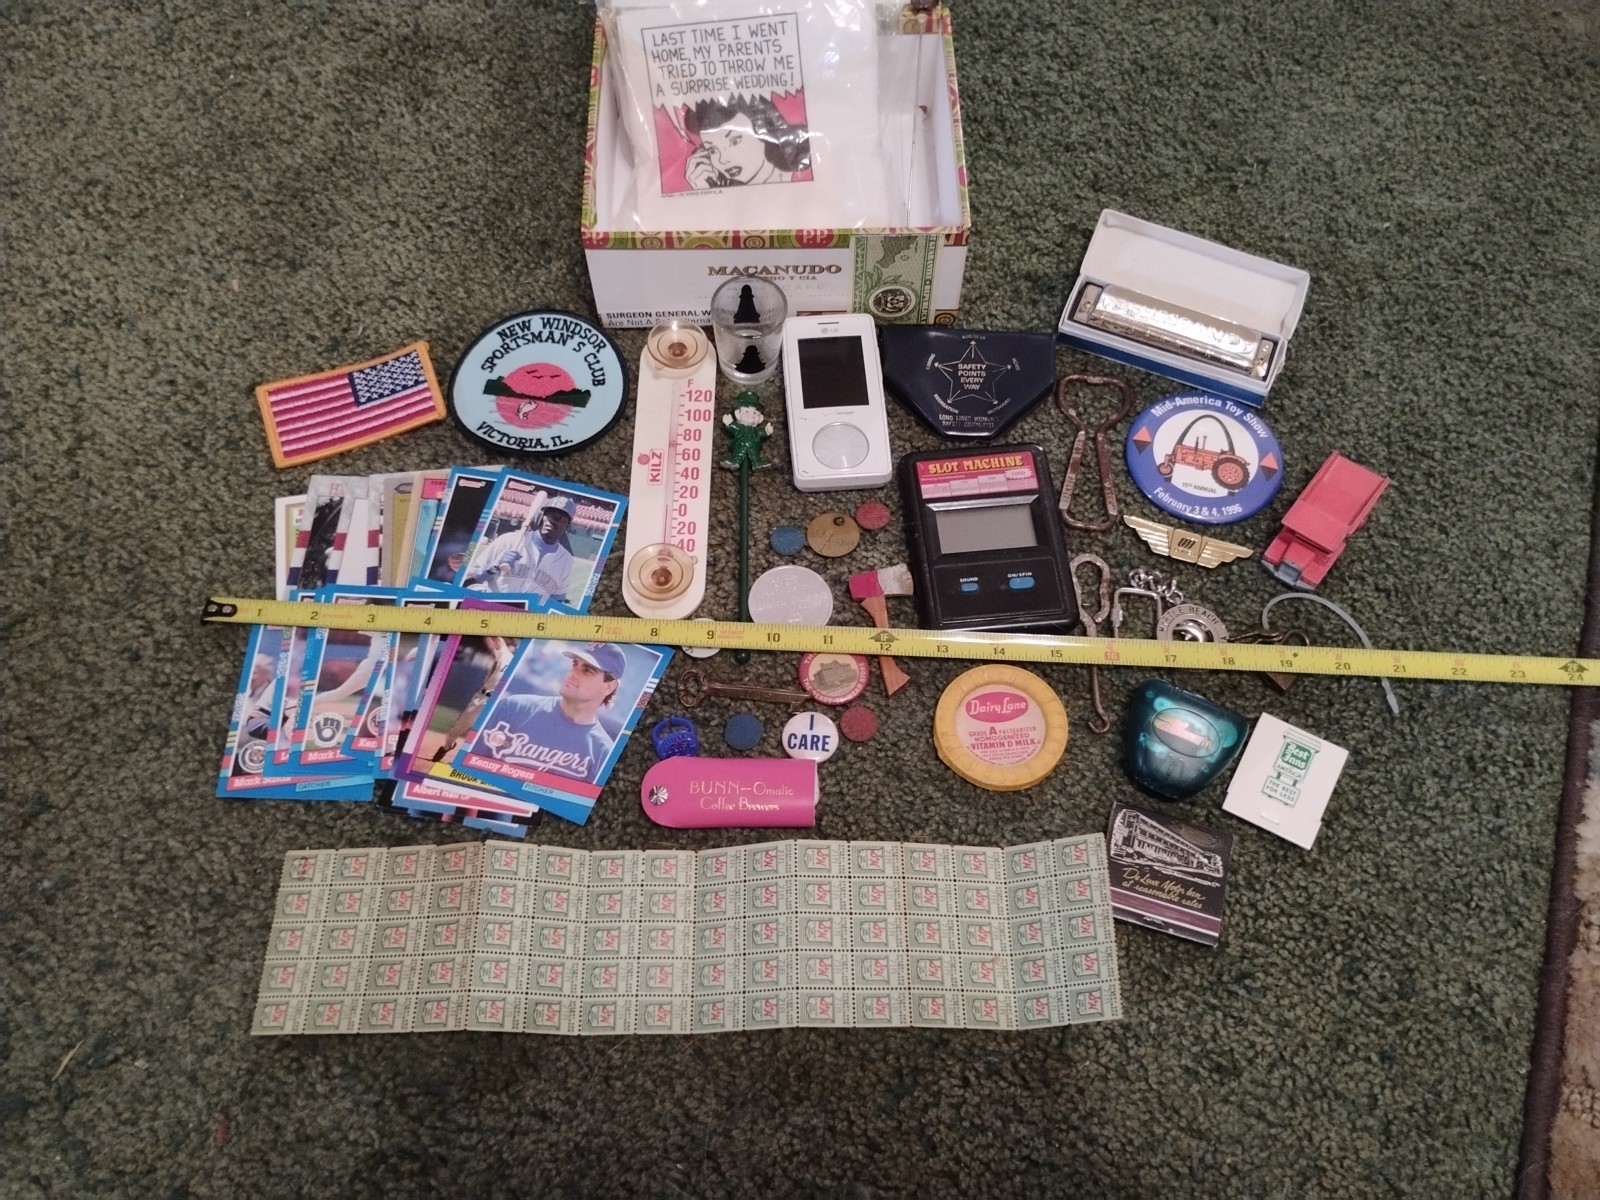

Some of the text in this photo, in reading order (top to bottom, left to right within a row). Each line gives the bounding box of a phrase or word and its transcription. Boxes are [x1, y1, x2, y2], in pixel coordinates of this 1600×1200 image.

[652, 21, 787, 47] LAST TIME I WENT
[694, 45, 711, 60] MY
[718, 39, 782, 58] PARENTS
[659, 55, 794, 80] TRIED TO THROW ME
[656, 84, 665, 97] A
[671, 77, 730, 96] SURPRISE
[707, 264, 842, 276] MACANUDO
[606, 311, 653, 320] SURGEON
[655, 310, 699, 318] GENERAL
[497, 317, 607, 353] NEW WINDSOR
[584, 352, 606, 387] CLUB
[687, 379, 694, 388] F
[686, 389, 713, 402] 120
[684, 409, 711, 422] 100
[938, 413, 954, 421] LONG
[1151, 395, 1269, 439] Mid-America Toy Show
[683, 428, 702, 442] 80
[681, 448, 701, 462] 60
[649, 451, 663, 483] KILZ
[928, 455, 1024, 474] SLOT MACHINE
[680, 467, 700, 480] 40
[679, 485, 699, 499] 20
[1192, 483, 1217, 495] ANNUAL
[1153, 486, 1192, 515] February
[1194, 505, 1200, 515] 3
[1200, 506, 1210, 516] &
[1221, 503, 1243, 516] 1996
[678, 503, 687, 517] 0
[677, 521, 697, 535] 20
[677, 538, 696, 552] 40
[257, 608, 262, 616] 1
[310, 611, 319, 620] 2
[367, 613, 376, 623] 3
[423, 616, 432, 626] 4
[480, 619, 489, 629] 5
[1159, 606, 1219, 633] MYRTLE BEACH
[536, 622, 545, 632] 6
[594, 625, 602, 634] 7
[650, 627, 658, 637] 8
[706, 630, 715, 639] 9
[766, 632, 780, 643] 10
[823, 635, 834, 645] 11
[880, 643, 892, 652] 12
[936, 644, 949, 653] 13
[993, 646, 1006, 656] 14
[1050, 649, 1063, 658] 15
[1105, 652, 1119, 661] 16
[1165, 654, 1177, 663] 17
[1222, 657, 1235, 666] 18
[1280, 659, 1293, 668] 19
[1334, 662, 1351, 671] 20
[1393, 664, 1407, 673] 21
[803, 678, 812, 692] THE
[858, 662, 867, 683] STORE
[1451, 667, 1467, 676] 22
[1510, 670, 1526, 679] 23
[1568, 673, 1584, 682] 24
[969, 697, 1027, 715] Dairy Lane
[809, 714, 814, 731] I
[989, 726, 997, 735] A
[787, 733, 831, 752] CARE
[974, 733, 1030, 742] HOMOGENIZED
[970, 738, 1036, 750] VITAMIN D MILK
[307, 751, 335, 761] Mark
[508, 732, 590, 773] Rangers
[1287, 743, 1310, 760] Best
[1283, 752, 1306, 768] Inns
[469, 756, 535, 780] Kenny Rogers
[1276, 763, 1302, 778] AMERICA
[413, 785, 441, 796] Albert
[524, 783, 554, 795] PITCHER
[1266, 785, 1295, 801] FOR LESS
[1268, 780, 1297, 795] THE BEST
[700, 797, 780, 811] Coffee Brewers
[1122, 880, 1203, 909] at reasonable rates
[1161, 879, 1185, 895] Motor
[1186, 887, 1206, 900] Inn
